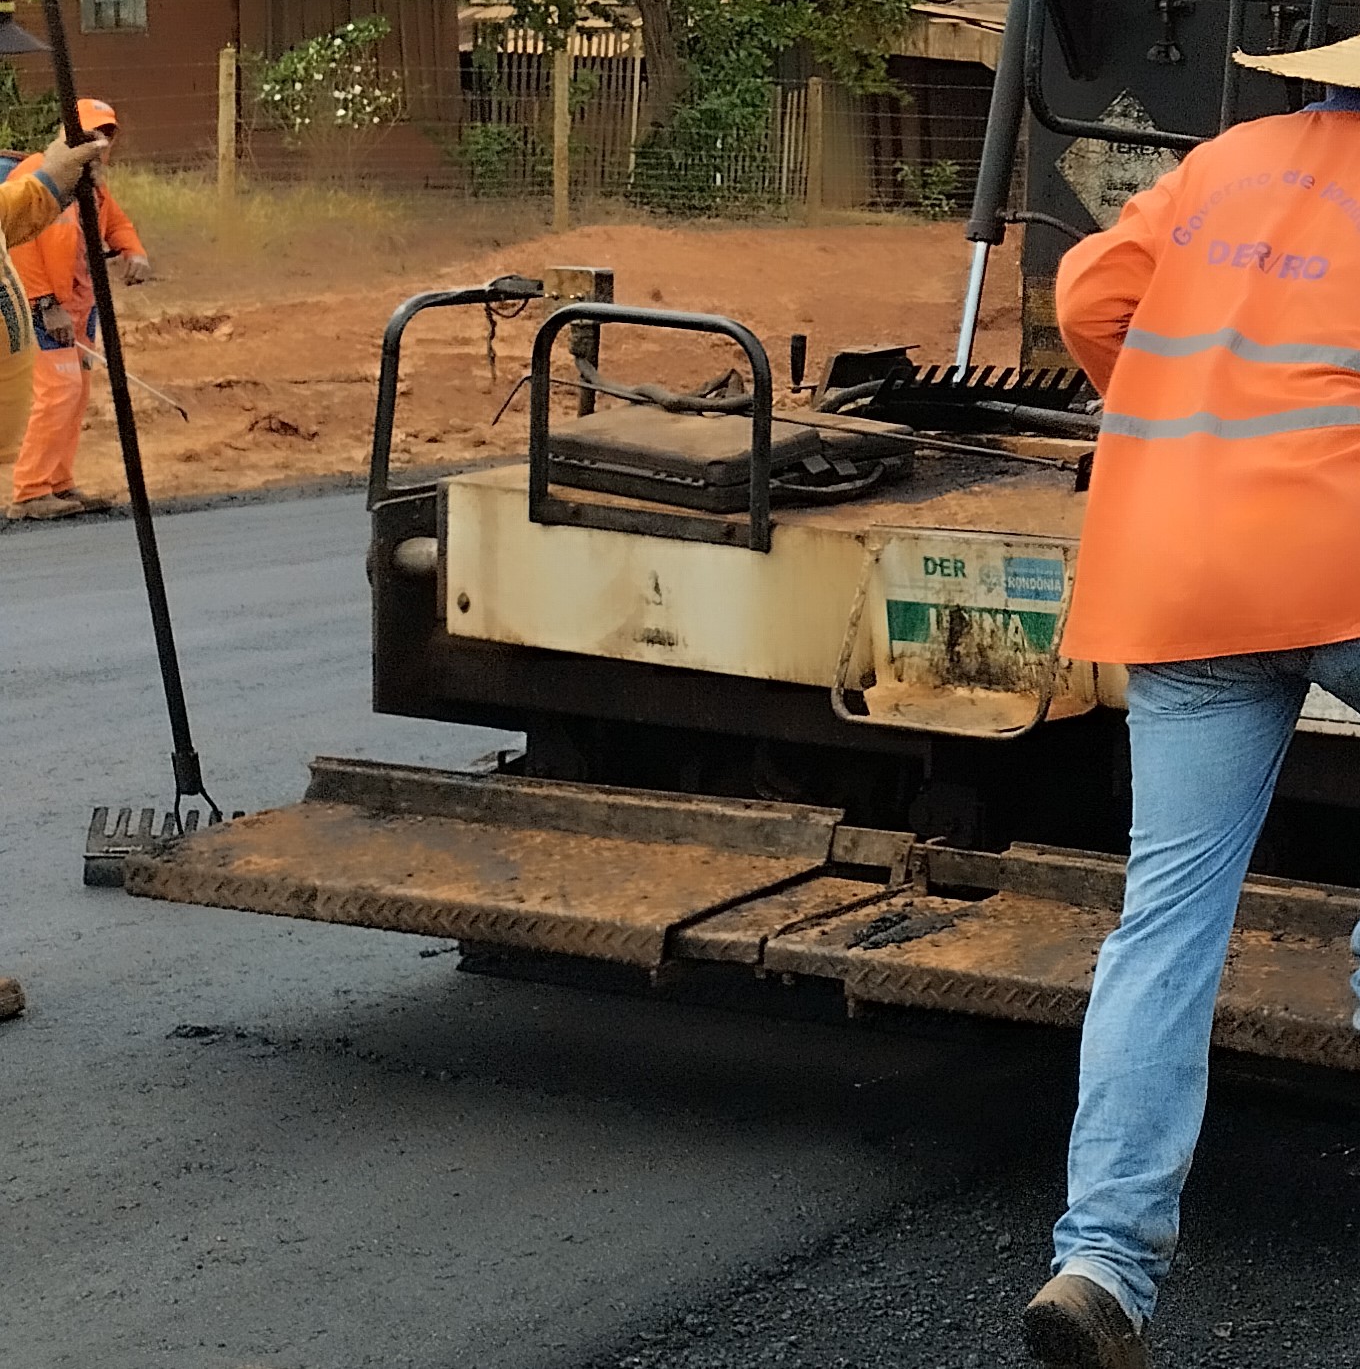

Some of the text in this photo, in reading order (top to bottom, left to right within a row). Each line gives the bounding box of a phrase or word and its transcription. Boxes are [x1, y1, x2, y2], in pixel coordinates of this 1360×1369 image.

[1171, 171, 1272, 246] Governo
[1282, 168, 1316, 190] de
[923, 556, 967, 579] DER
